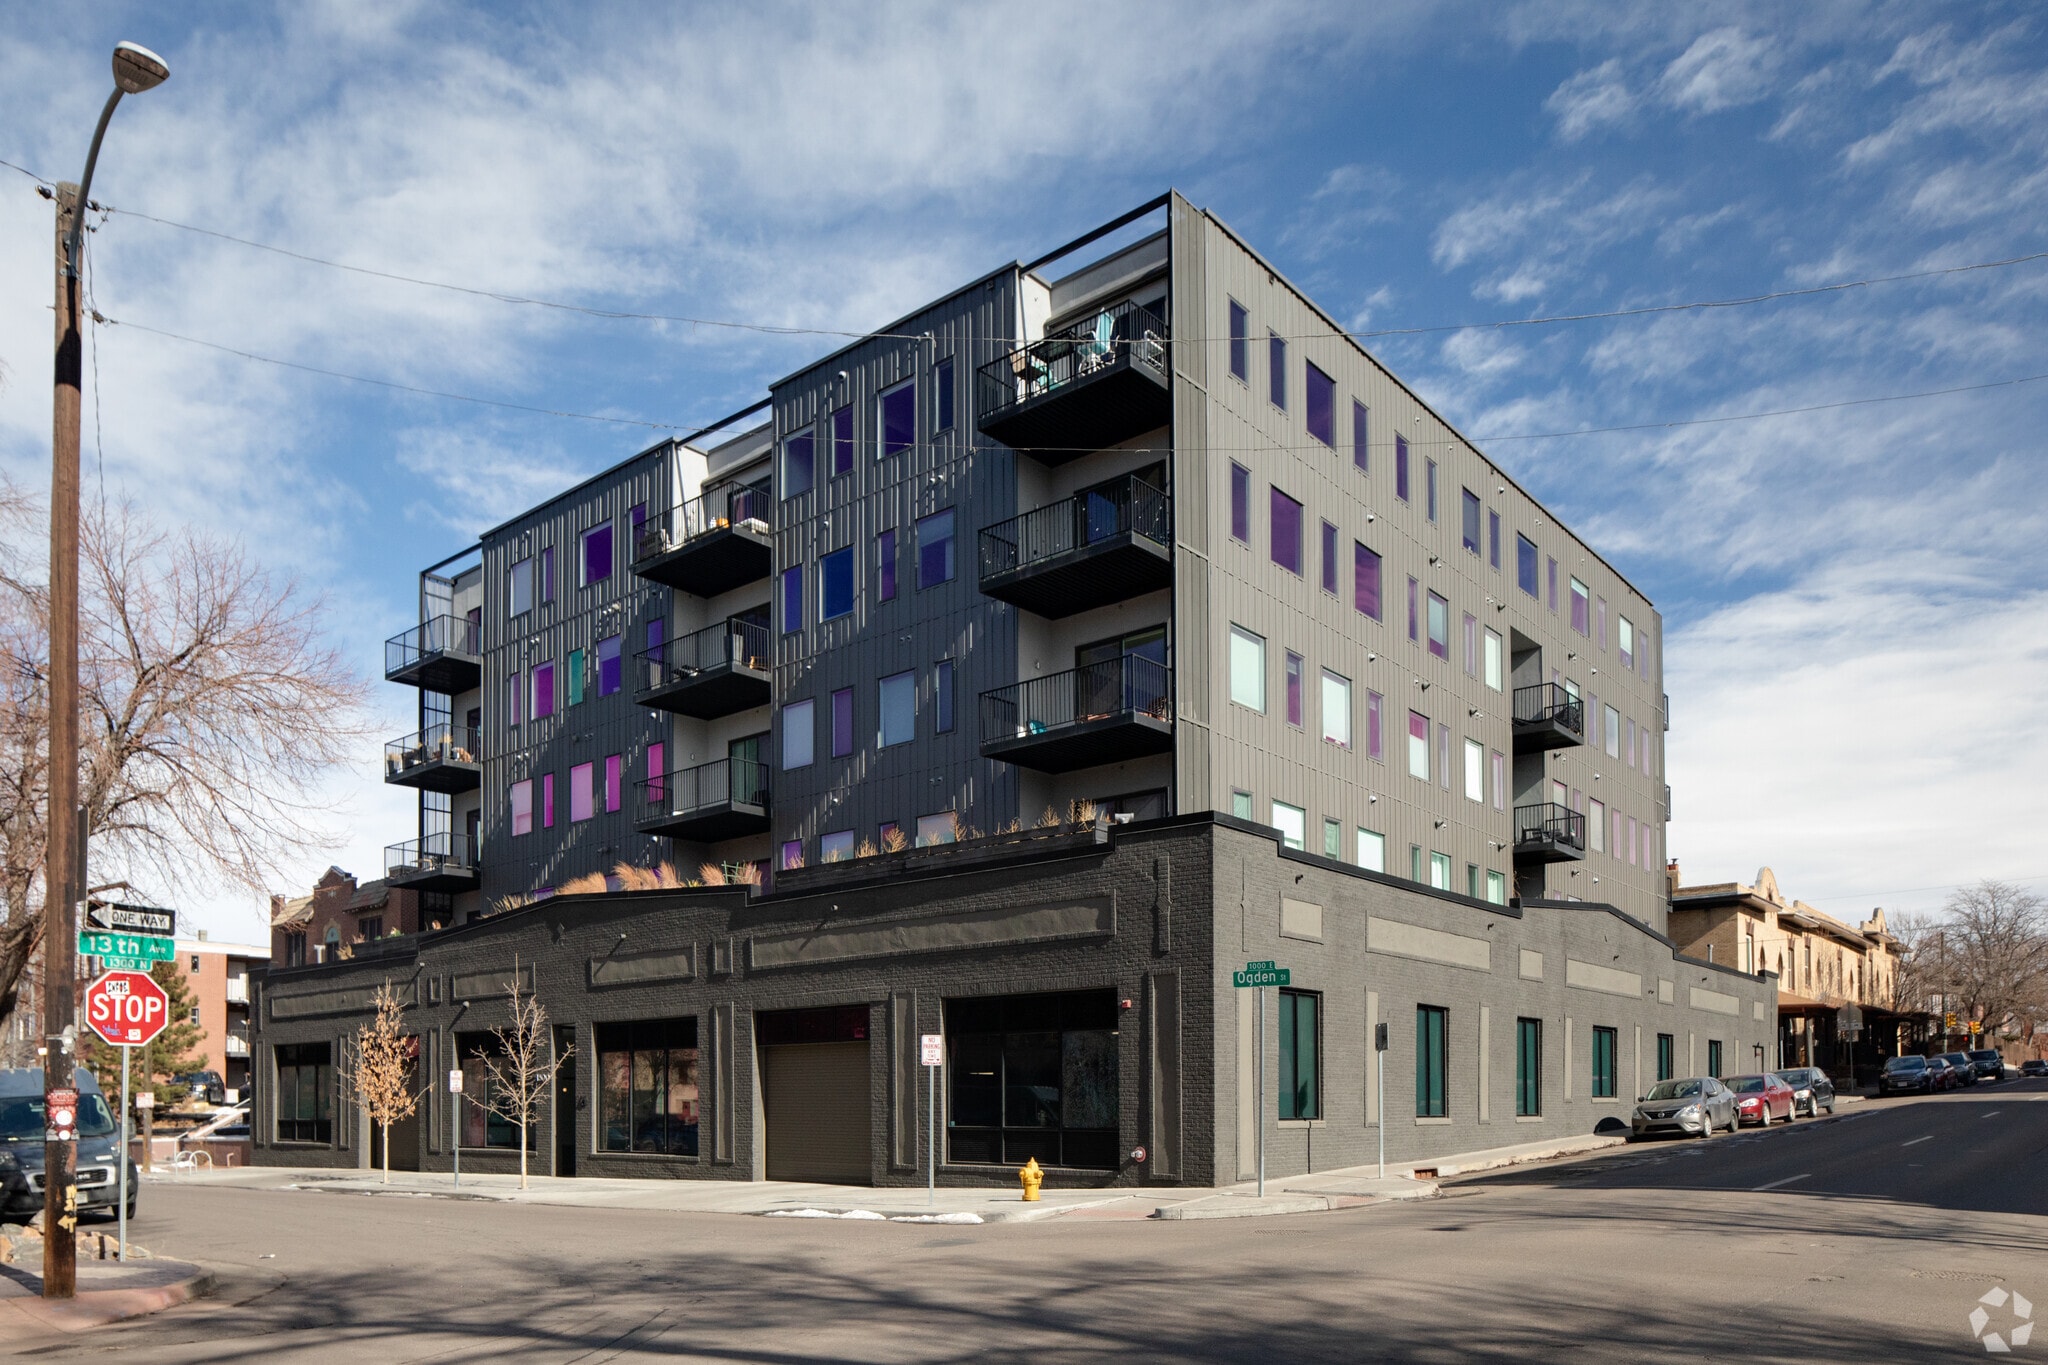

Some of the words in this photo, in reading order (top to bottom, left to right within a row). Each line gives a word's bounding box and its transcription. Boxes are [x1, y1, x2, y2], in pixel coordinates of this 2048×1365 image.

[112, 911, 135, 924] ONE
[140, 914, 166, 927] WAY
[90, 936, 139, 955] 13th
[149, 945, 166, 954] Ave
[110, 958, 135, 968] 1300
[140, 960, 147, 969] N
[1238, 971, 1276, 986] Ogden
[92, 993, 162, 1023] STOP
